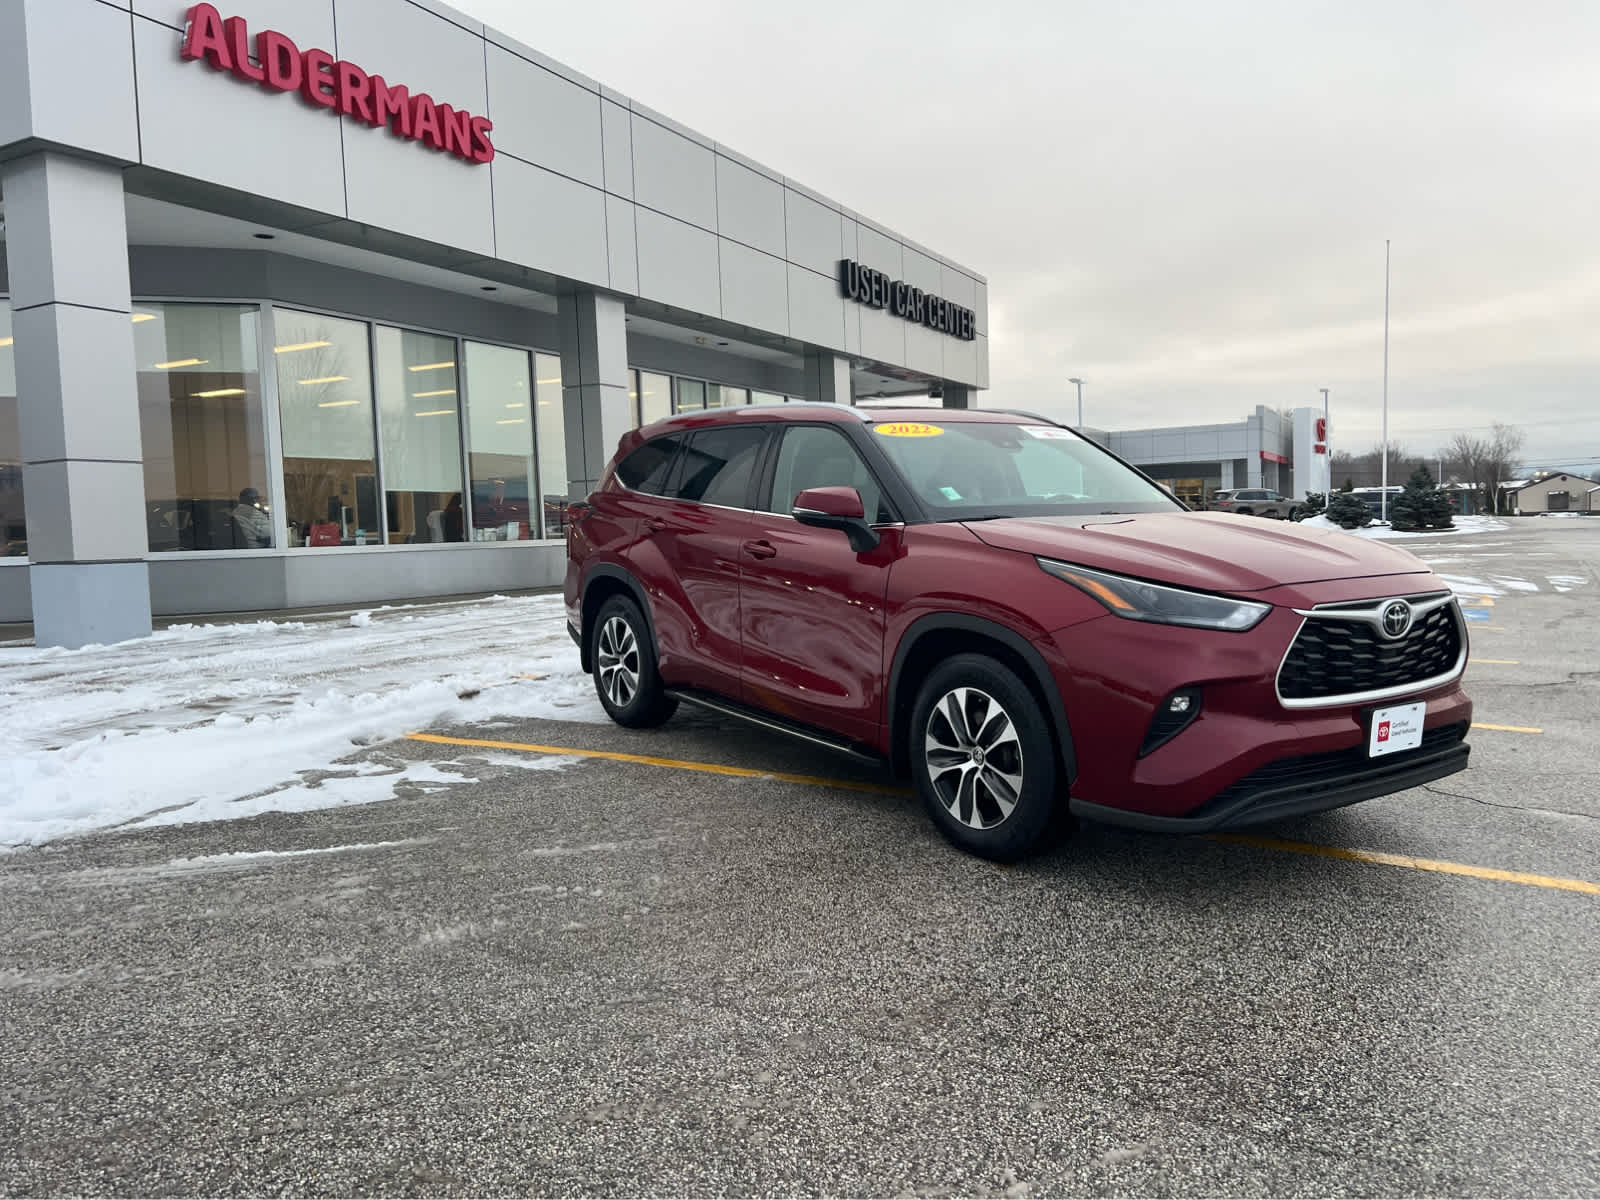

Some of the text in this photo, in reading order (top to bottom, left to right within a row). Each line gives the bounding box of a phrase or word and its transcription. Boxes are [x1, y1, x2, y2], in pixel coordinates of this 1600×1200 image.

[182, 3, 495, 164] ALDERMANS
[841, 259, 976, 340] USED CAR CENTER
[888, 425, 931, 434] 2022
